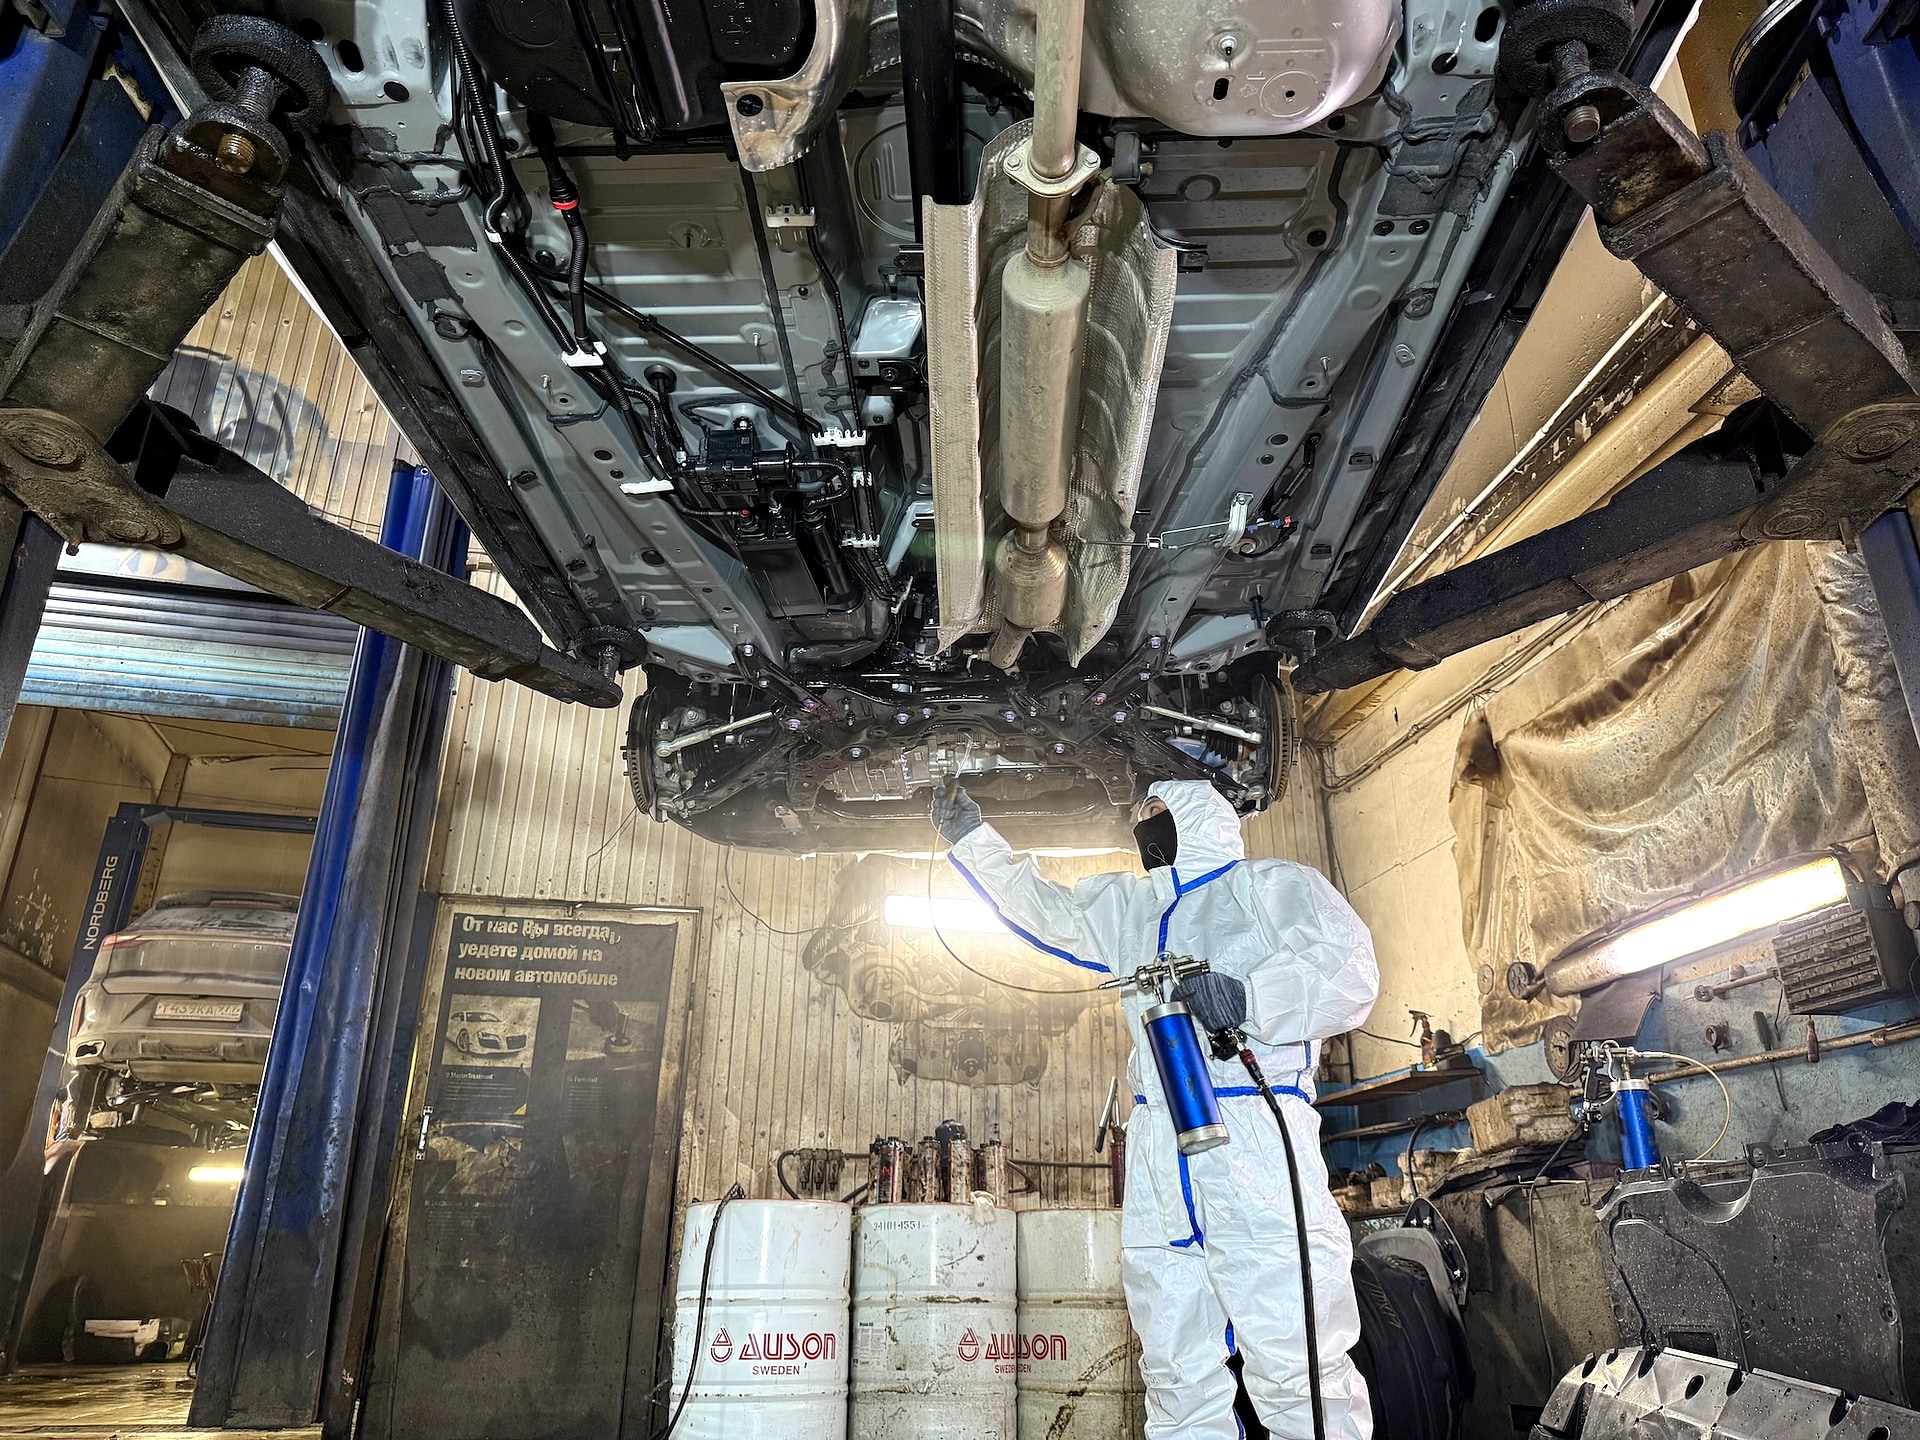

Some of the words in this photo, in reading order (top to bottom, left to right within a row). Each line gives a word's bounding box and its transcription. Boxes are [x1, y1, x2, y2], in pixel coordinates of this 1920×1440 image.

[82, 855, 119, 950] NORDBERG
[462, 915, 484, 932] От
[552, 924, 610, 941] всегда
[458, 942, 519, 958] уедете
[520, 945, 579, 961] домой
[582, 949, 603, 962] на
[454, 966, 511, 982] новом
[513, 969, 619, 986] автомобиле
[738, 1332, 837, 1361] AUSON
[752, 1365, 801, 1376] SWEDEN
